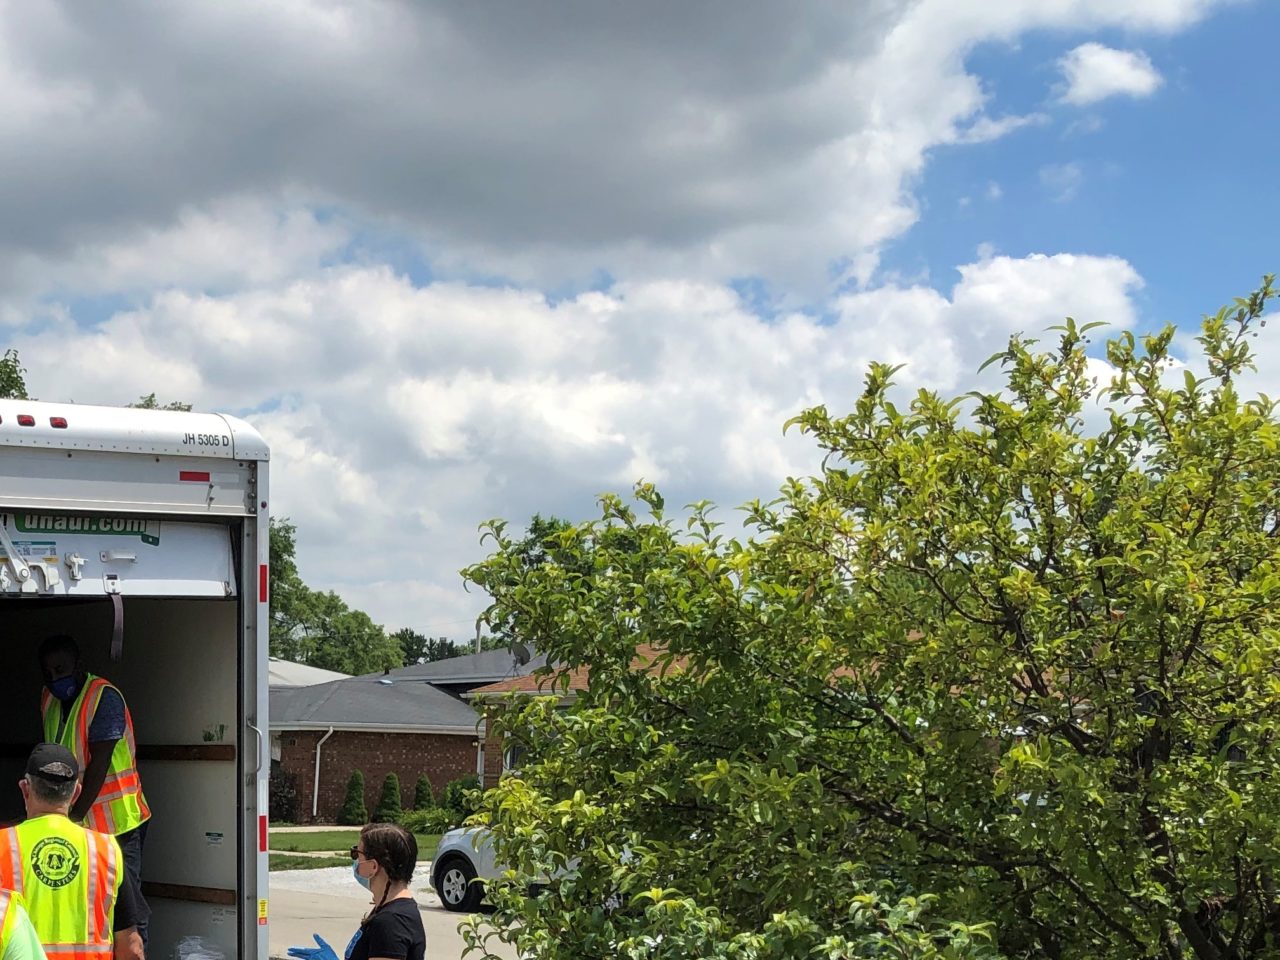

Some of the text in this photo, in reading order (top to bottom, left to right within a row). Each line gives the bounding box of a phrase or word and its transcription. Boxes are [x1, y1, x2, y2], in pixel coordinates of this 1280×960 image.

[182, 433, 230, 447] JH 5305 D
[35, 869, 77, 887] CARPENTERS
